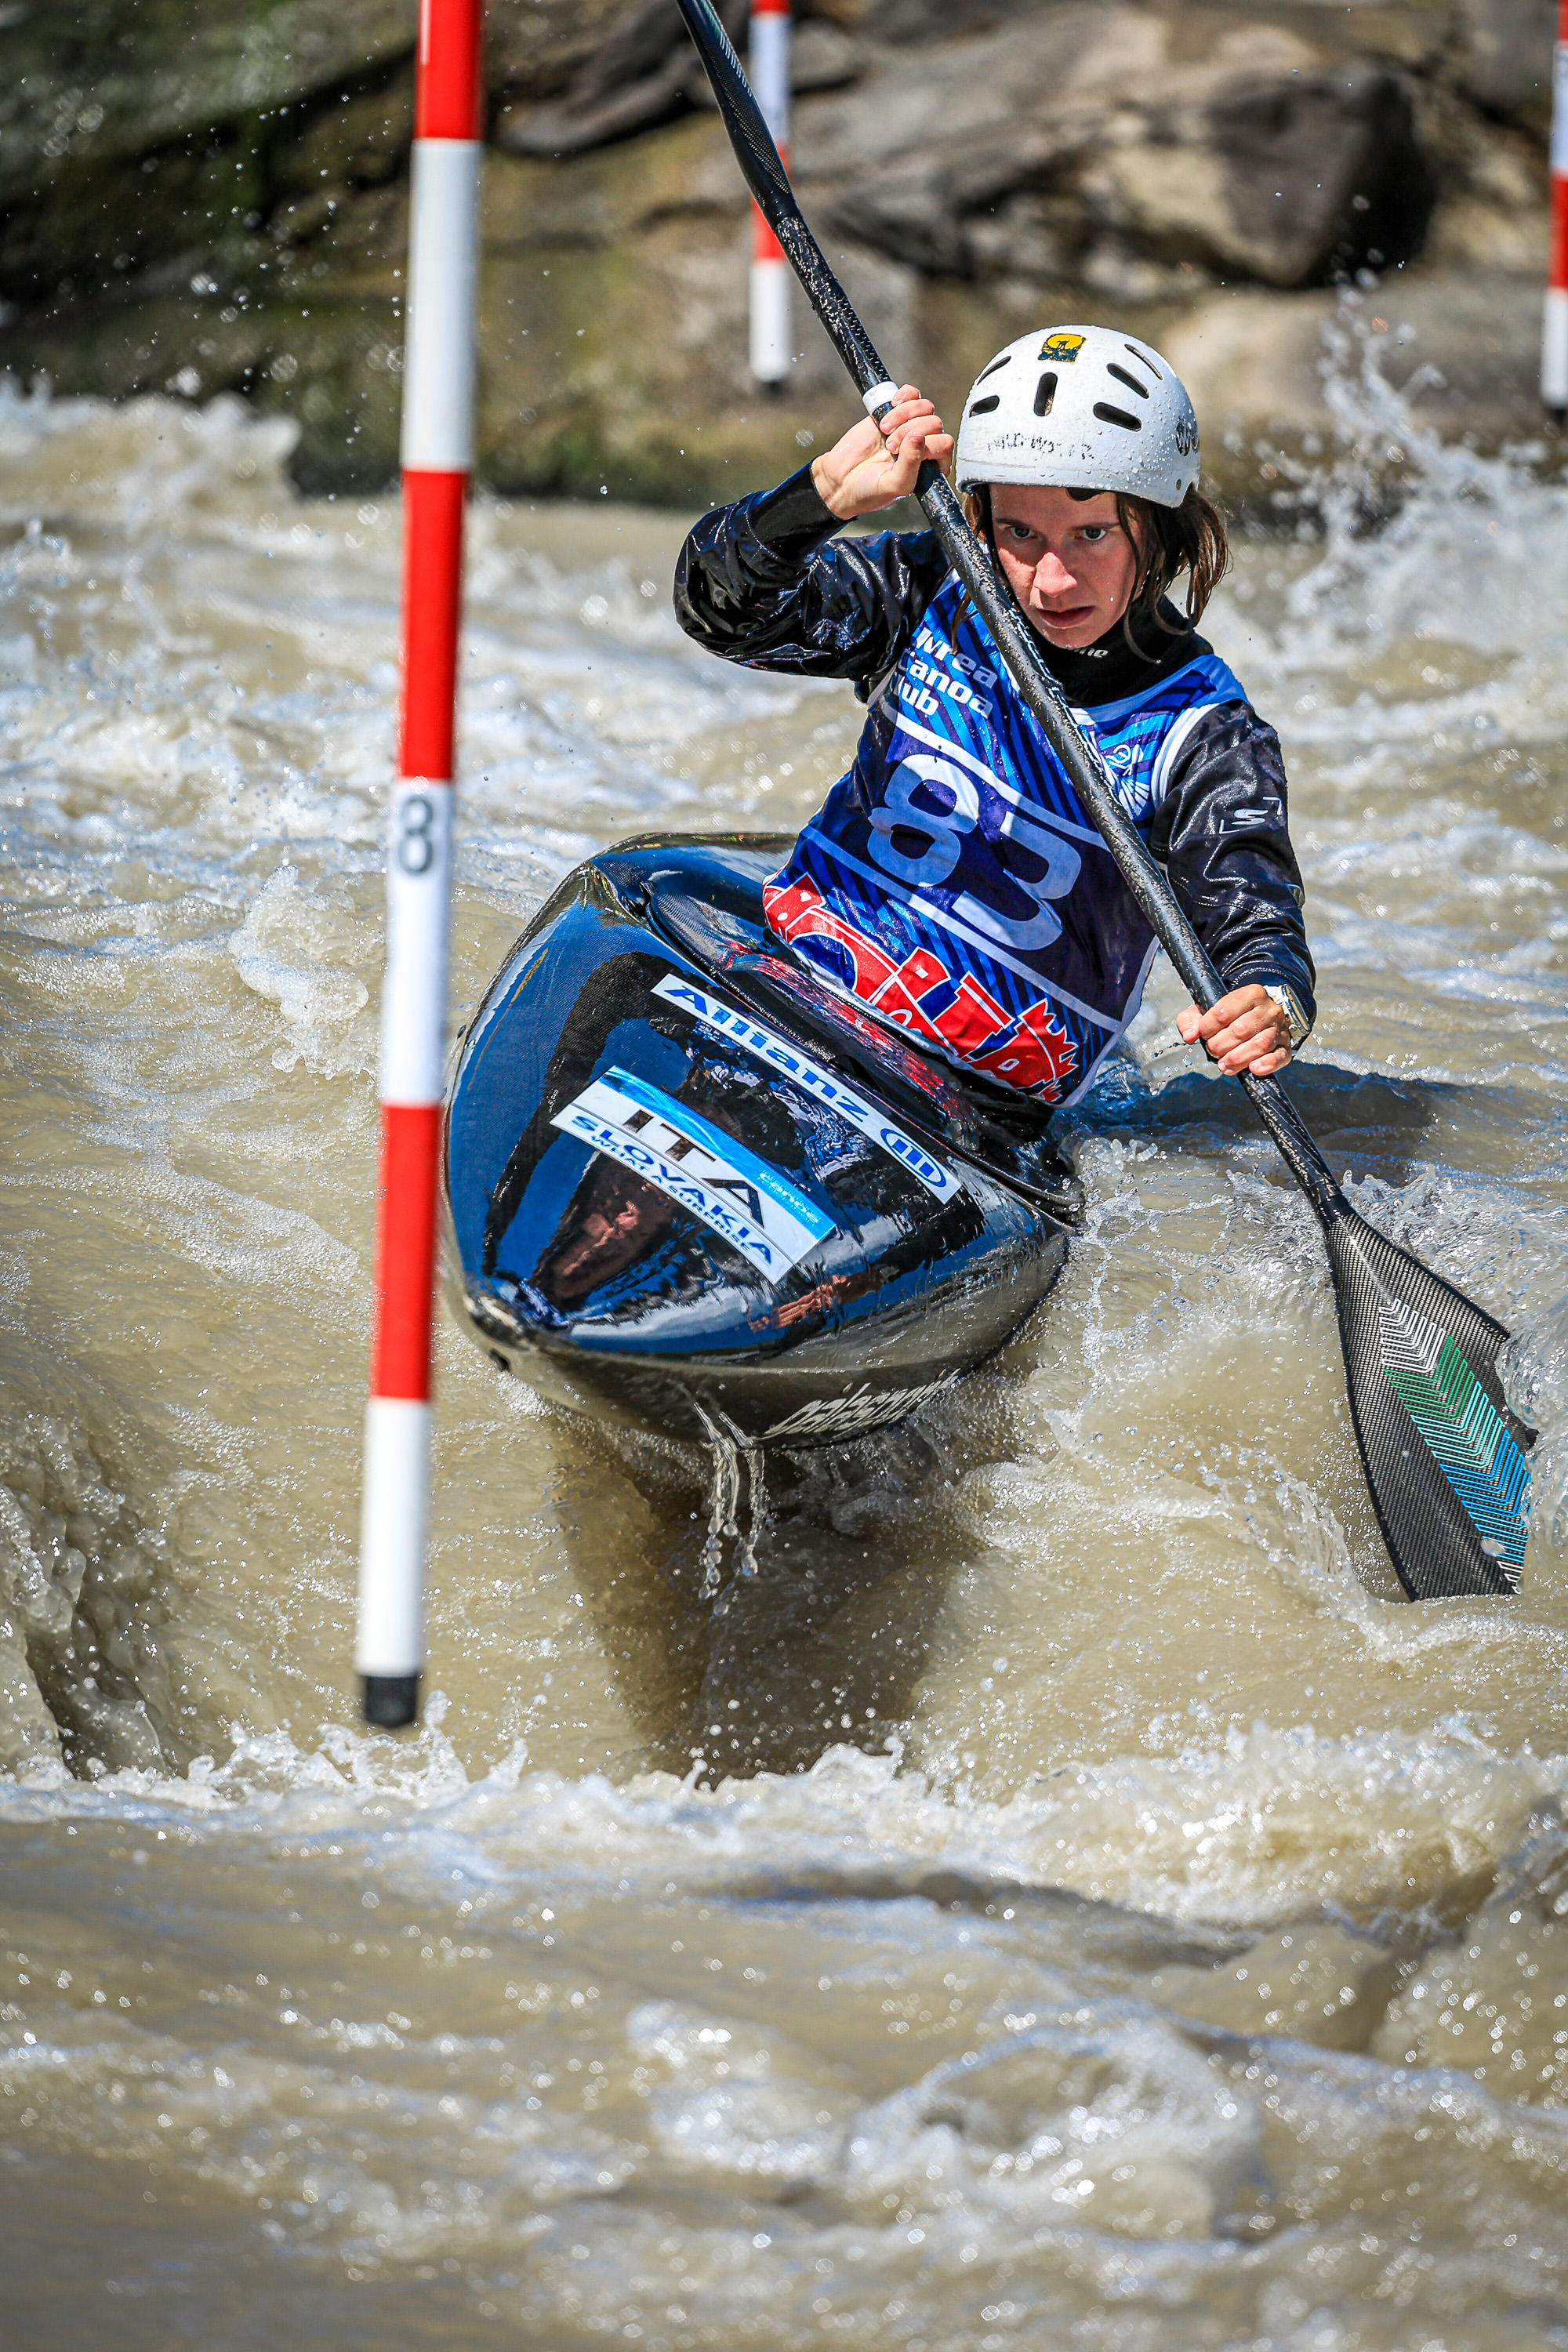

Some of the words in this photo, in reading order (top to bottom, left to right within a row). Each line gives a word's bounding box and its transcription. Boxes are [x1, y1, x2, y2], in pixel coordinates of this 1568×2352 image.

[898, 648, 993, 719] Canoa
[914, 627, 997, 689] Ivrea
[398, 794, 434, 877] 8
[866, 753, 1082, 951] 83
[664, 985, 869, 1123] Allianz
[572, 1115, 771, 1265] SLOVAKIA
[590, 1135, 649, 1172] WHAT
[651, 1174, 663, 1185] A
[666, 1185, 751, 1252] SURPRISE
[622, 1109, 765, 1229] ITA
[759, 1171, 818, 1225] canoe
